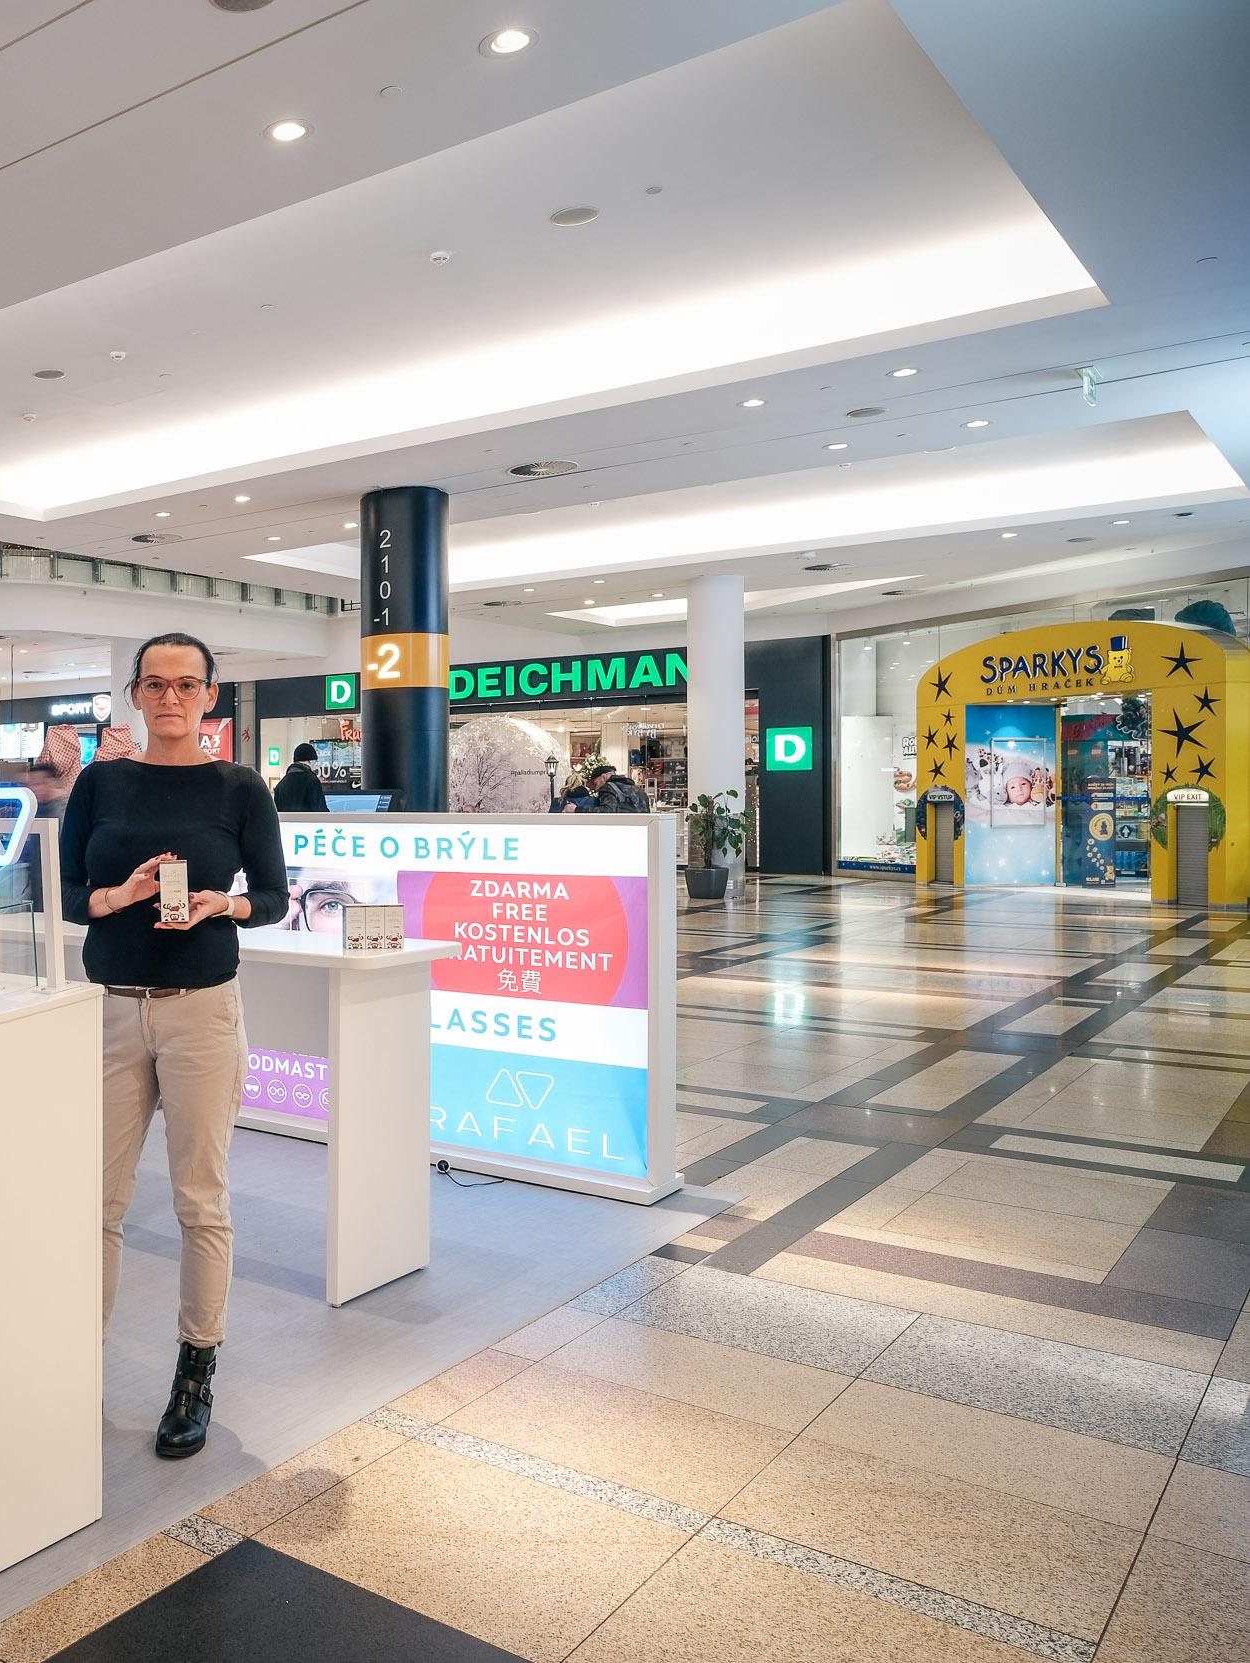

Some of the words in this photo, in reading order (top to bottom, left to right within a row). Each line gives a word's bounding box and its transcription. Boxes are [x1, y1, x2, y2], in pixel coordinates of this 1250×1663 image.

[373, 607, 390, 626] -1
[367, 643, 401, 680] -2
[980, 644, 1105, 684] SPARKYS
[449, 652, 688, 700] DEICHMAN
[1029, 678, 1094, 692] HRAČEK
[330, 680, 351, 704] D
[50, 702, 92, 717] SPORT
[775, 734, 806, 763] D
[1187, 793, 1202, 801] EXIT
[294, 829, 366, 858] PÉČE
[379, 836, 400, 860] O
[414, 831, 520, 861] BRÝLE
[469, 880, 569, 900] ZDARMA
[492, 902, 547, 921] FREE
[454, 922, 590, 947] KOSTENLOS
[449, 942, 613, 972] ATUITEMENT
[497, 968, 542, 995] 免費
[431, 1007, 557, 1042] ASSES
[431, 1107, 625, 1161] RAFAEL
